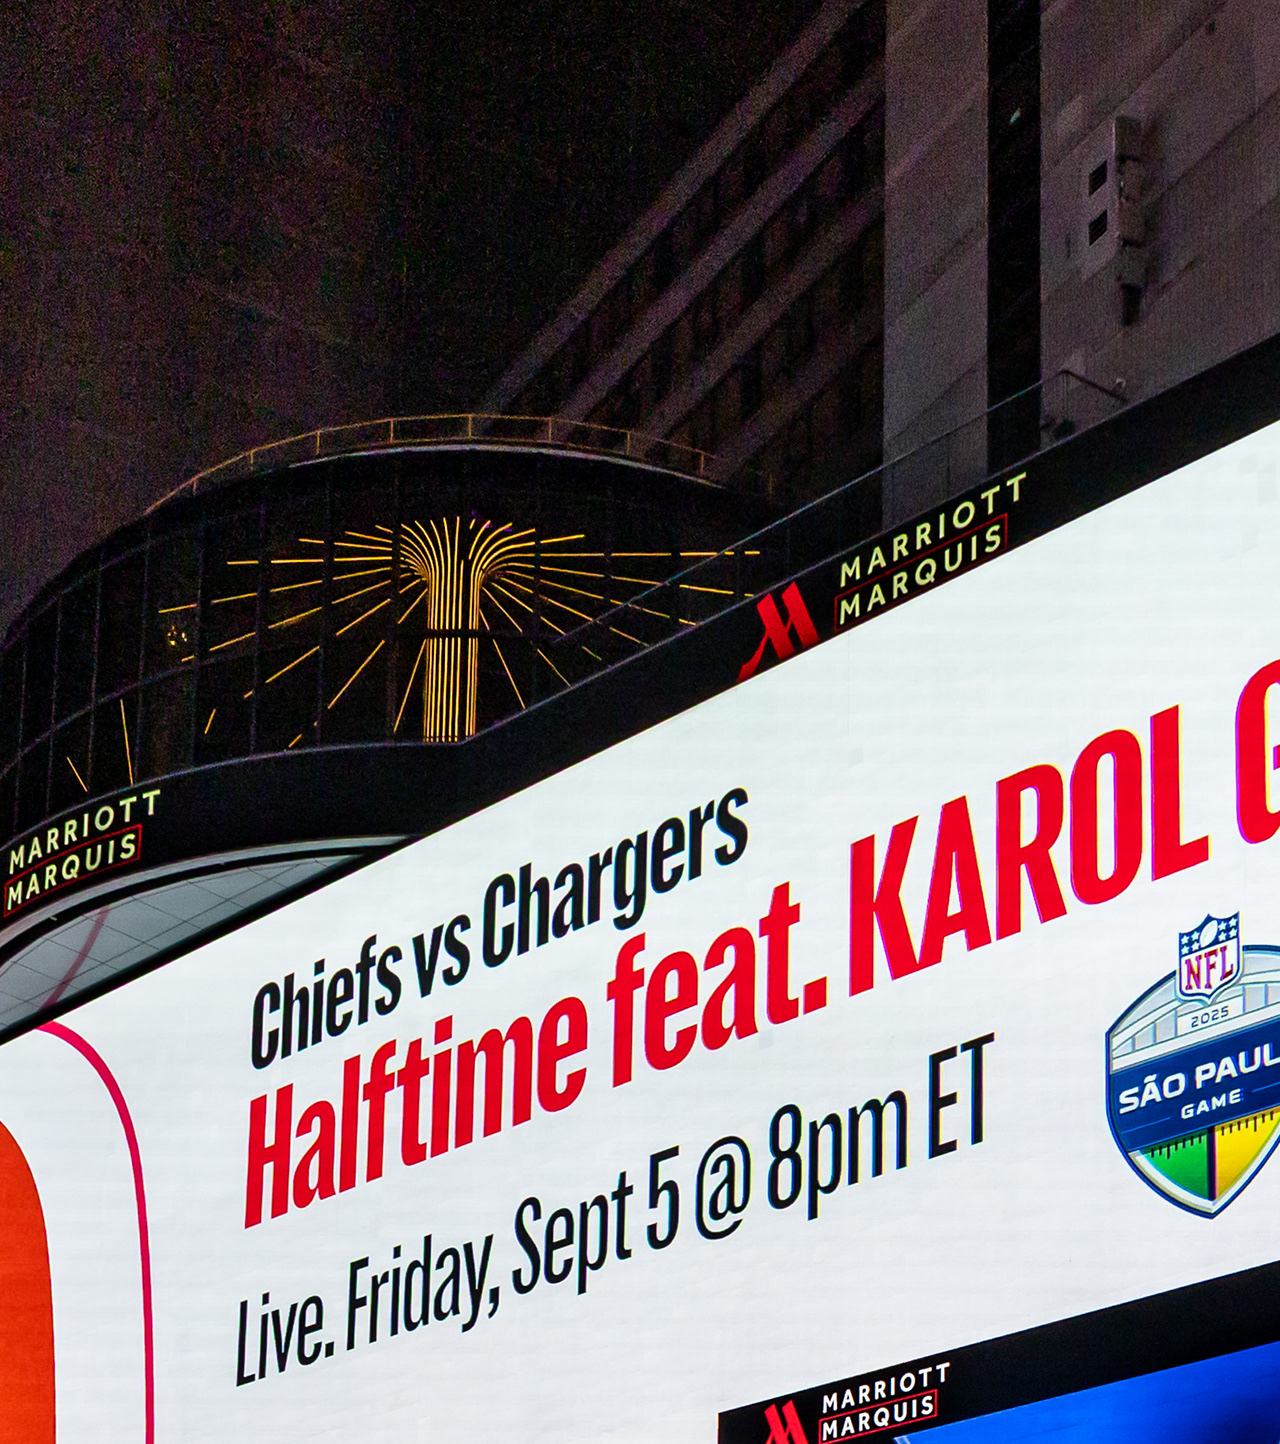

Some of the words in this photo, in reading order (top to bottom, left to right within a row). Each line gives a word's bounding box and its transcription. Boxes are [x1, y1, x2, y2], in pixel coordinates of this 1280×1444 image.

[840, 471, 1027, 588] MARRIOTT
[839, 525, 1001, 625] MARQUIS
[9, 789, 161, 875] MARRIOTT
[7, 833, 136, 911] MARQUIS
[242, 992, 589, 1230] Halftime
[608, 880, 828, 1087] feat.
[848, 701, 1210, 998] KAROL
[250, 933, 403, 1071] Chiefs
[411, 909, 472, 999] vs
[481, 785, 750, 971] Chargers
[1184, 945, 1235, 990] NFL
[1190, 1006, 1230, 1028] 2025
[1119, 1074, 1186, 1114] SÃO
[1180, 1088, 1242, 1120] GAME
[234, 1292, 334, 1388] Live.
[344, 1230, 502, 1354] Friday,
[511, 1171, 635, 1302] Sept
[645, 1147, 681, 1252] 5
[693, 1133, 754, 1242] @
[766, 1085, 910, 1221] 8pm
[926, 1031, 996, 1162] ET
[822, 1362, 951, 1414] MARRIOTT
[822, 1395, 934, 1441] MARQUIS
